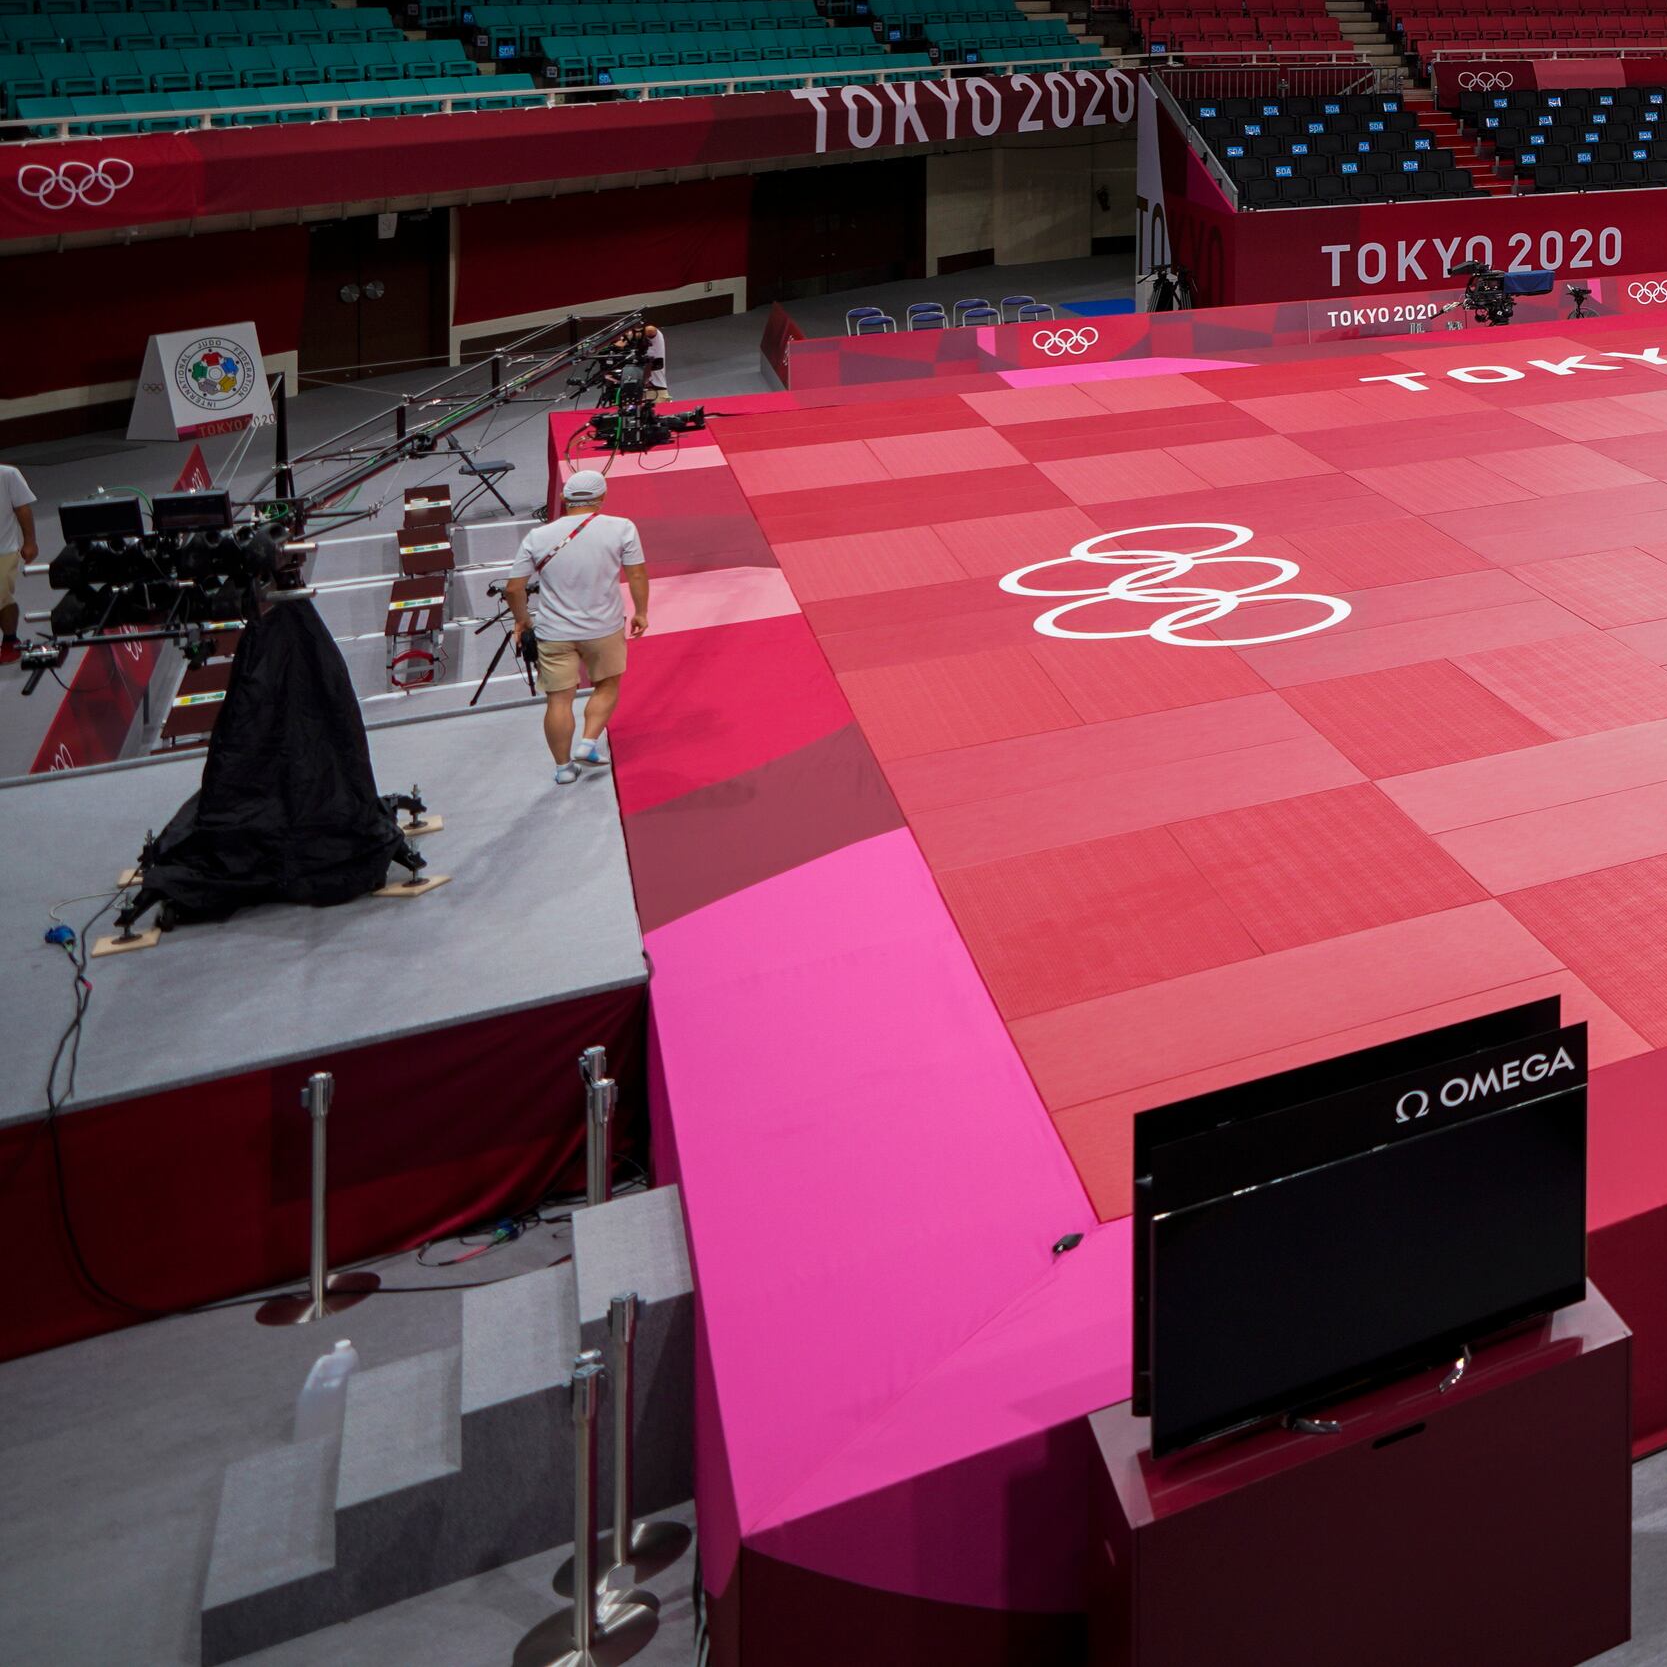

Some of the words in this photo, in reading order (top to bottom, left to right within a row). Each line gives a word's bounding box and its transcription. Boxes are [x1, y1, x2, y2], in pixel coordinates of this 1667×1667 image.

[498, 45, 519, 58] SDA
[1152, 45, 1165, 54] SDA
[1494, 98, 1508, 108] SDA
[792, 76, 1001, 154] TOKYO
[1017, 68, 1135, 133] 2020
[1200, 108, 1217, 118] SDA
[1262, 106, 1280, 116] SDA
[1324, 104, 1341, 114] SDA
[1244, 125, 1262, 136] SDA
[1308, 123, 1325, 134] SDA
[1368, 121, 1385, 132] SDA
[1292, 144, 1309, 154] SDA
[1414, 139, 1430, 150] SDA
[1226, 146, 1245, 158] SDA
[1340, 163, 1359, 174] SDA
[1402, 160, 1419, 172] SDA
[1274, 166, 1294, 178] SDA
[1321, 235, 1493, 287] TOKYO
[1508, 226, 1623, 273] 2020
[1327, 308, 1389, 328] TOKYO
[1394, 303, 1437, 323] 2020
[178, 354, 216, 408] INTERNATIONAL
[198, 340, 222, 350] JUDO
[234, 347, 254, 398] FEDERATION
[198, 418, 244, 438] TOKYO
[1438, 1046, 1576, 1108] OMEGA
